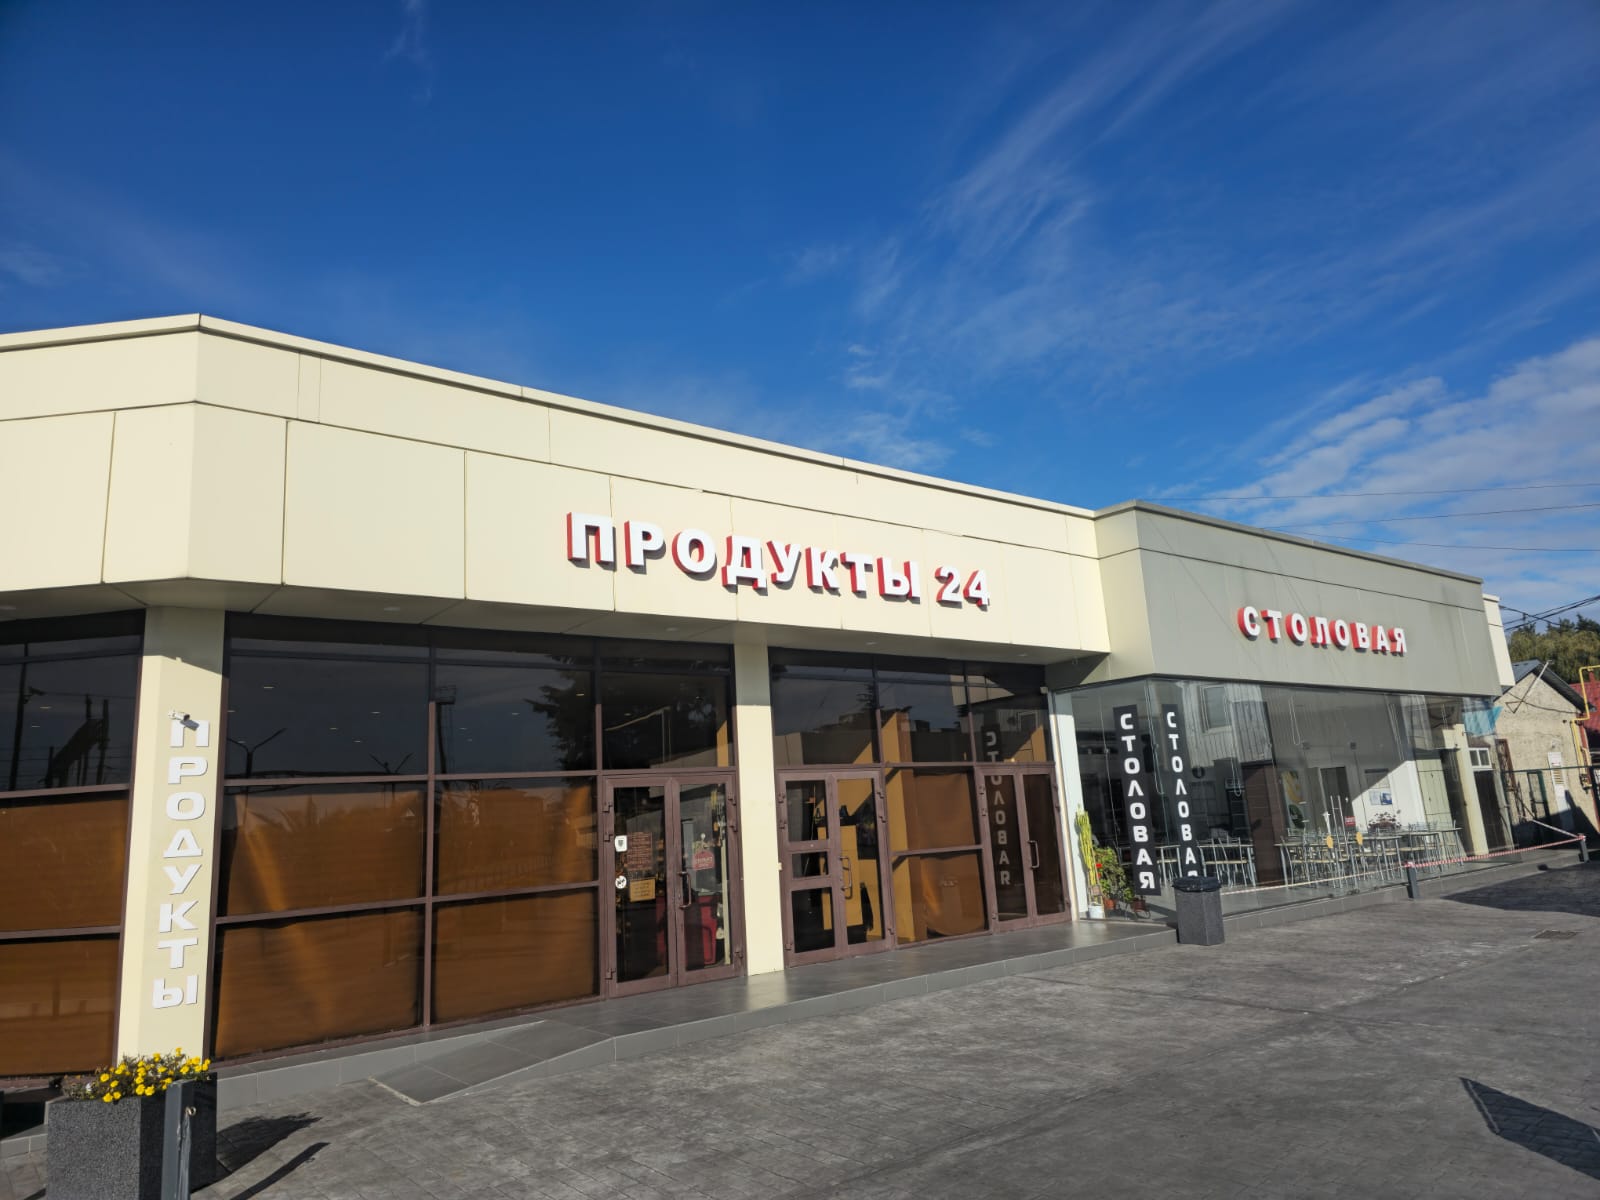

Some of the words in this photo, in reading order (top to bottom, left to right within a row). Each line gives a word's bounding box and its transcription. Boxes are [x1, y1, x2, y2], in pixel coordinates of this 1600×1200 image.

[566, 511, 921, 599] ПРОДУКТЫ
[934, 565, 991, 608] 24
[1237, 606, 1408, 654] СТОЛОВАЯ
[153, 719, 210, 1009] ПРОДУКТЫ
[1120, 713, 1156, 889] СТОЛОВАЯ
